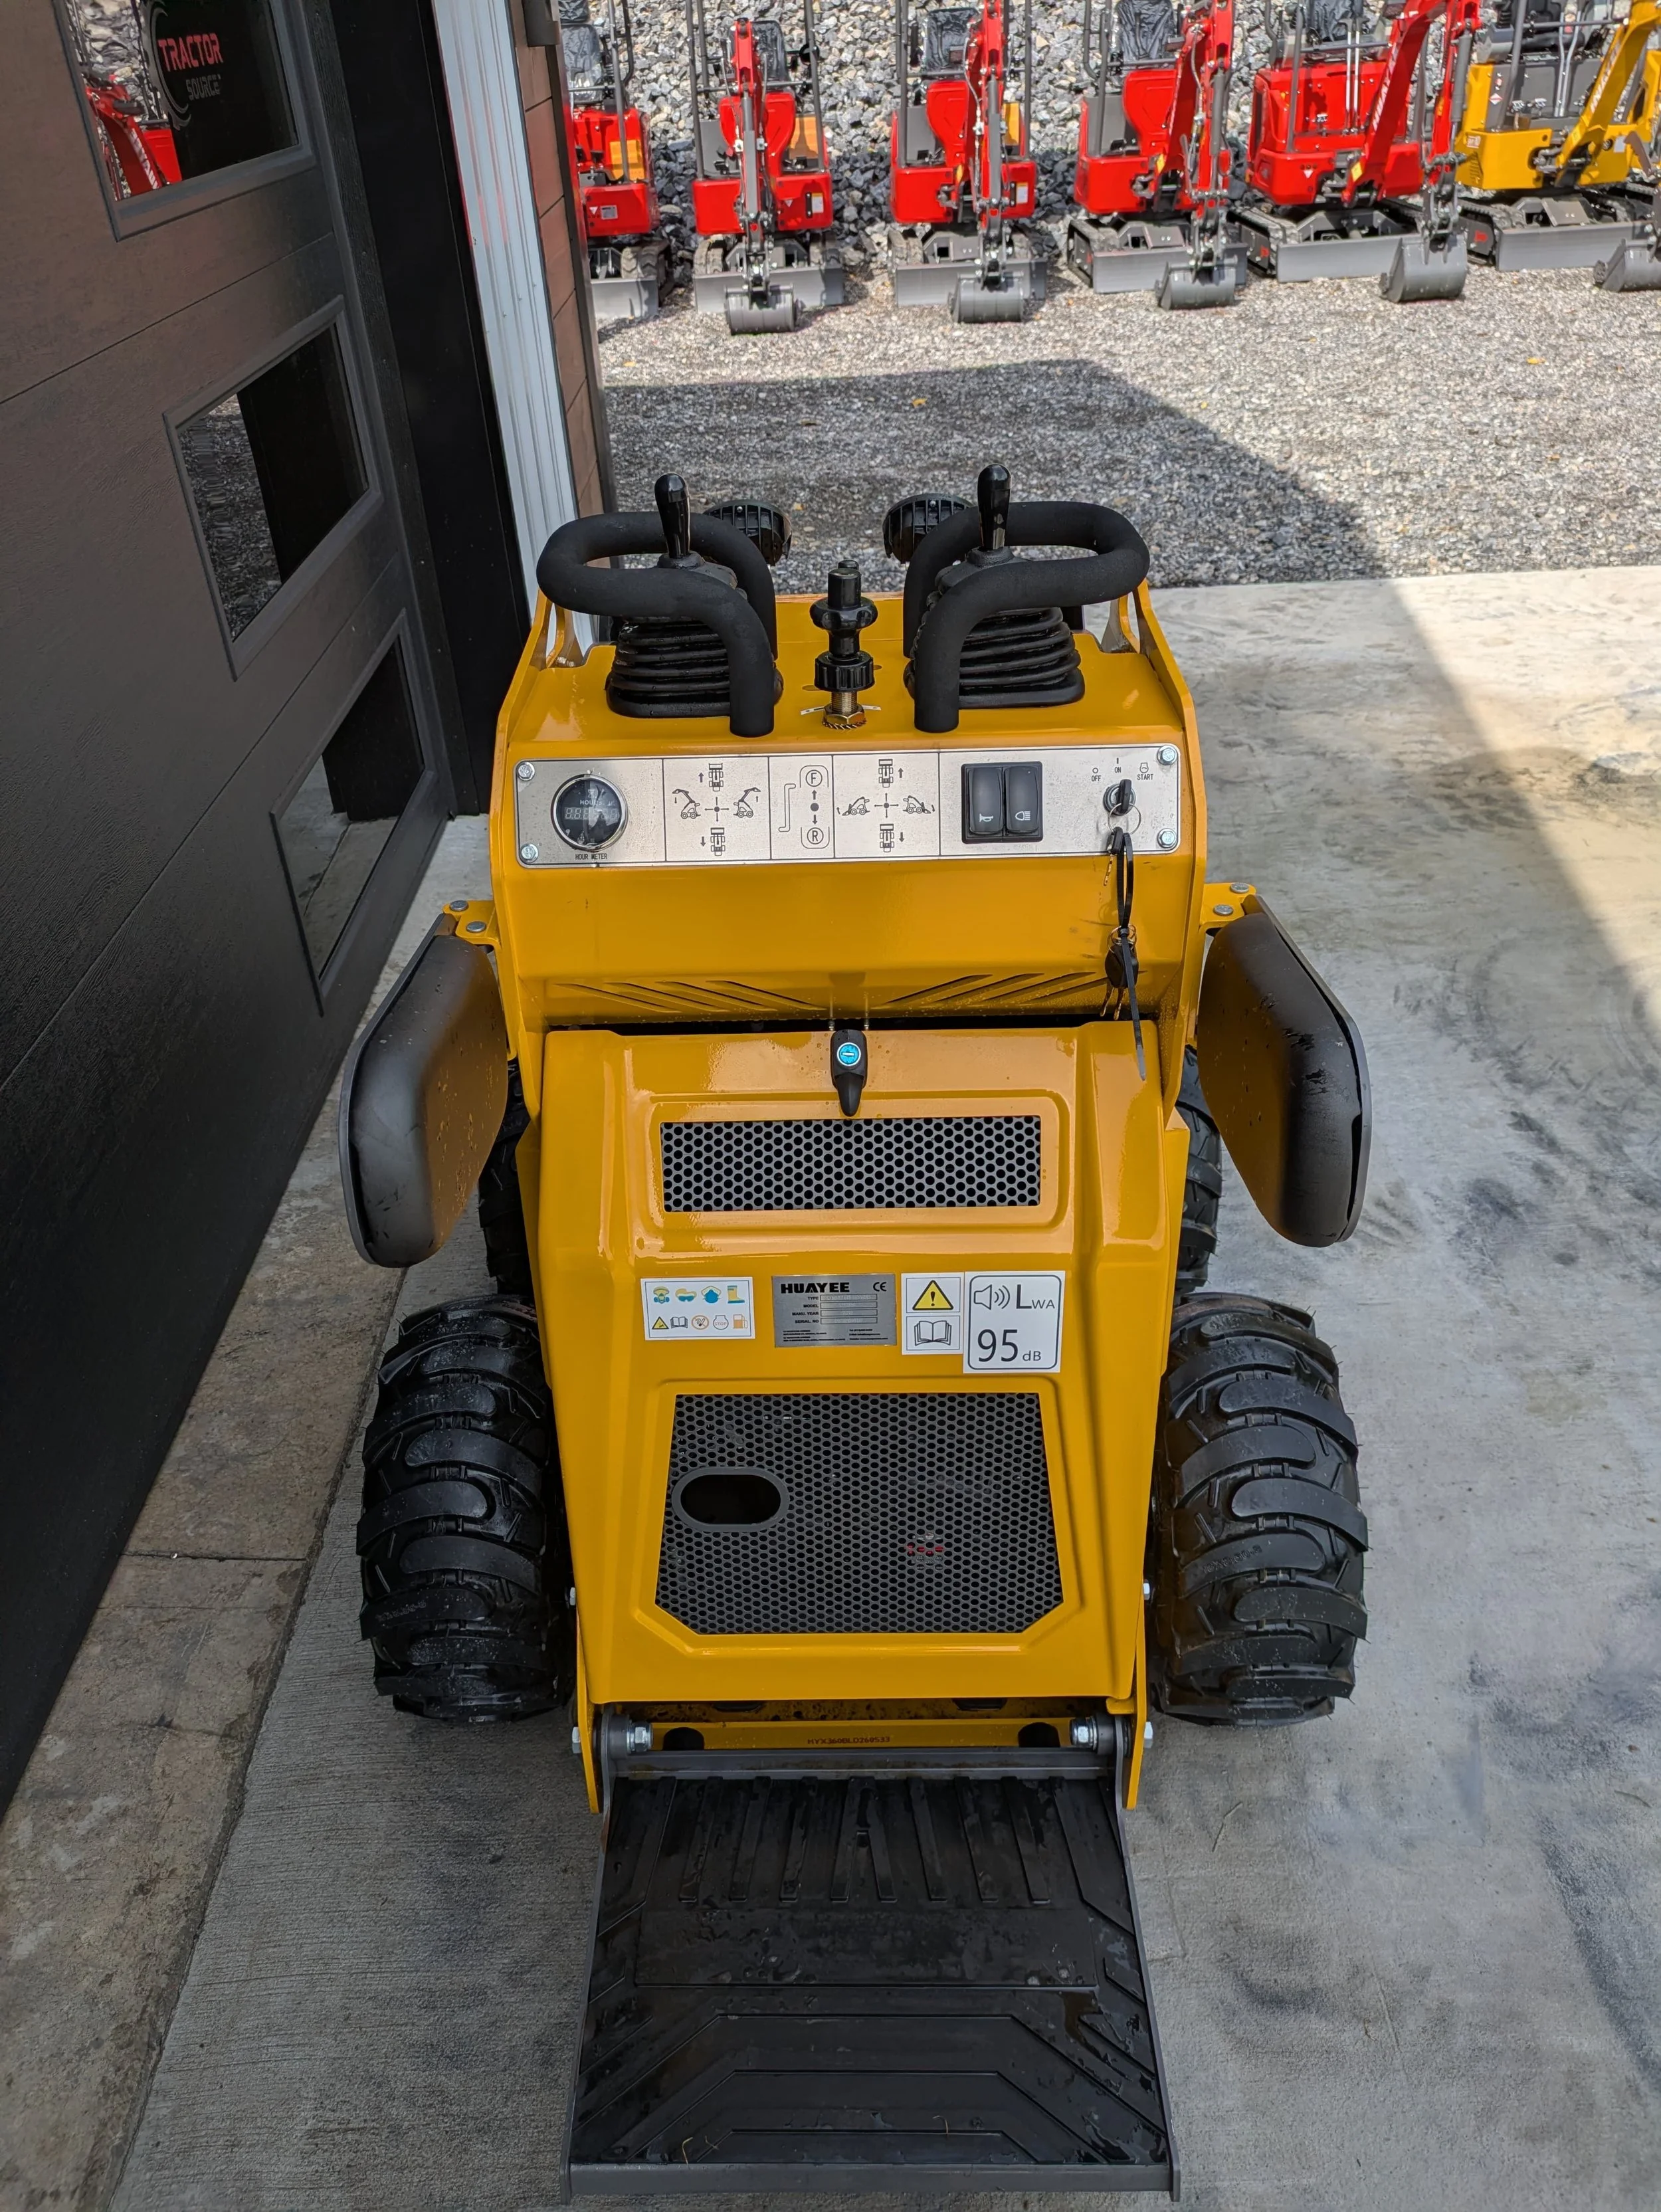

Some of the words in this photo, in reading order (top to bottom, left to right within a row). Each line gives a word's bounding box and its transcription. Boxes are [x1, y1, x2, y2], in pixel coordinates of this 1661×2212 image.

[158, 33, 223, 72] TRACTOR
[186, 74, 221, 101] SOURCE
[811, 772, 817, 784] F
[812, 830, 819, 842] R
[781, 1282, 850, 1294] HUAYEE
[872, 1282, 887, 1292] CE
[977, 1329, 1019, 1362] 95
[1023, 1350, 1041, 1361] dB
